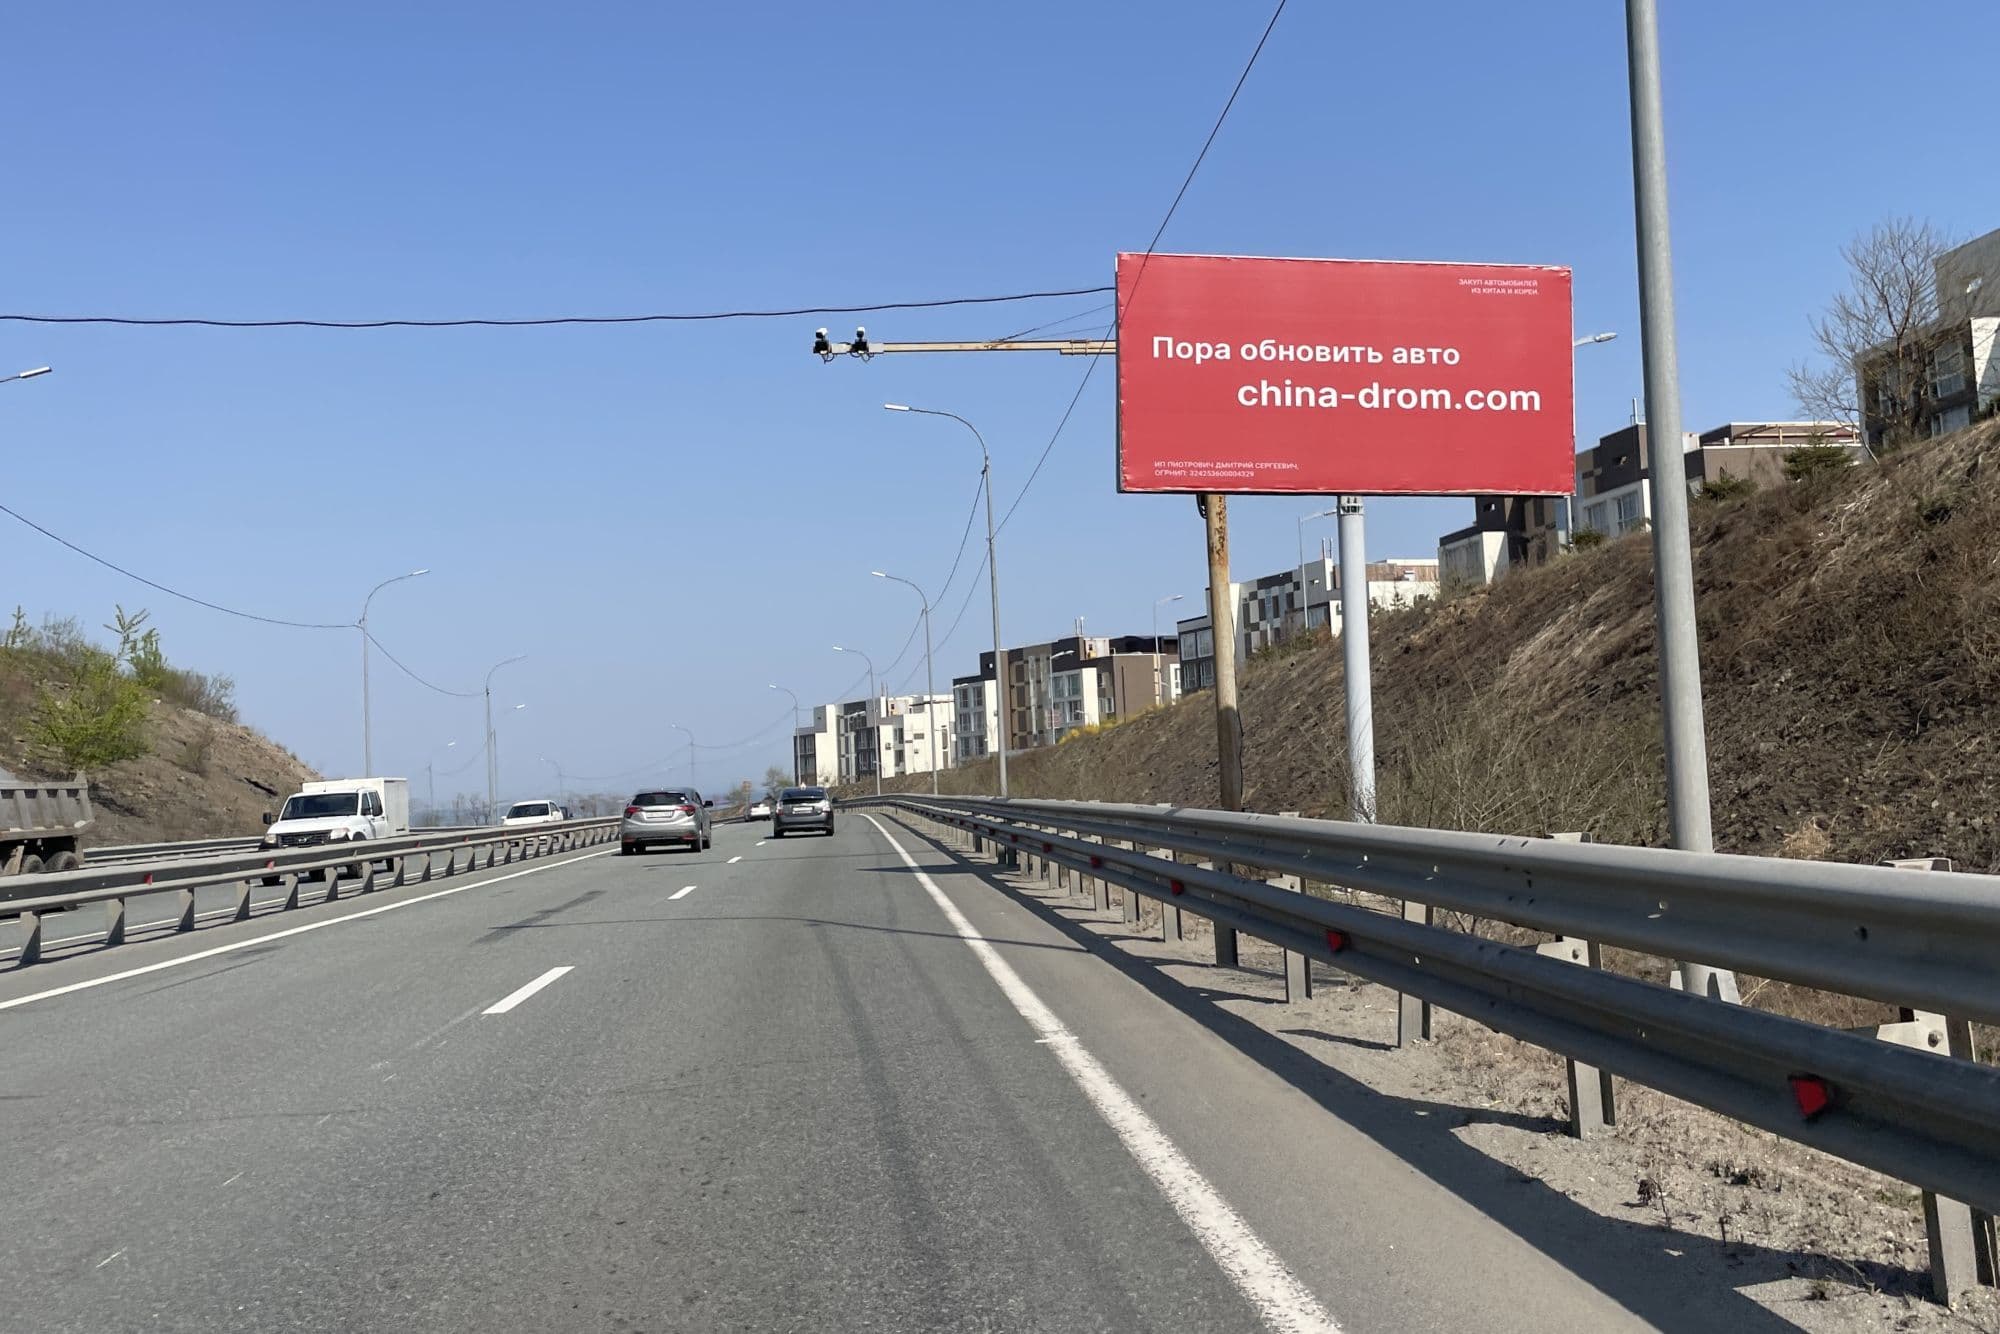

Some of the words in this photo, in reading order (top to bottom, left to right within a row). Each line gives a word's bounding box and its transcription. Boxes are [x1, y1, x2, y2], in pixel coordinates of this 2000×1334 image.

[1458, 278, 1482, 286] ЗАКУП
[1484, 279, 1538, 287] АВТОМОБИЛЕЙ
[1483, 287, 1506, 295] КИТАЯ
[1153, 336, 1231, 365] Пора
[1240, 339, 1384, 364] обновить
[1391, 346, 1460, 365] авто
[1237, 379, 1542, 411] china-drom.com
[1215, 461, 1254, 469] ДМИТРИЙ
